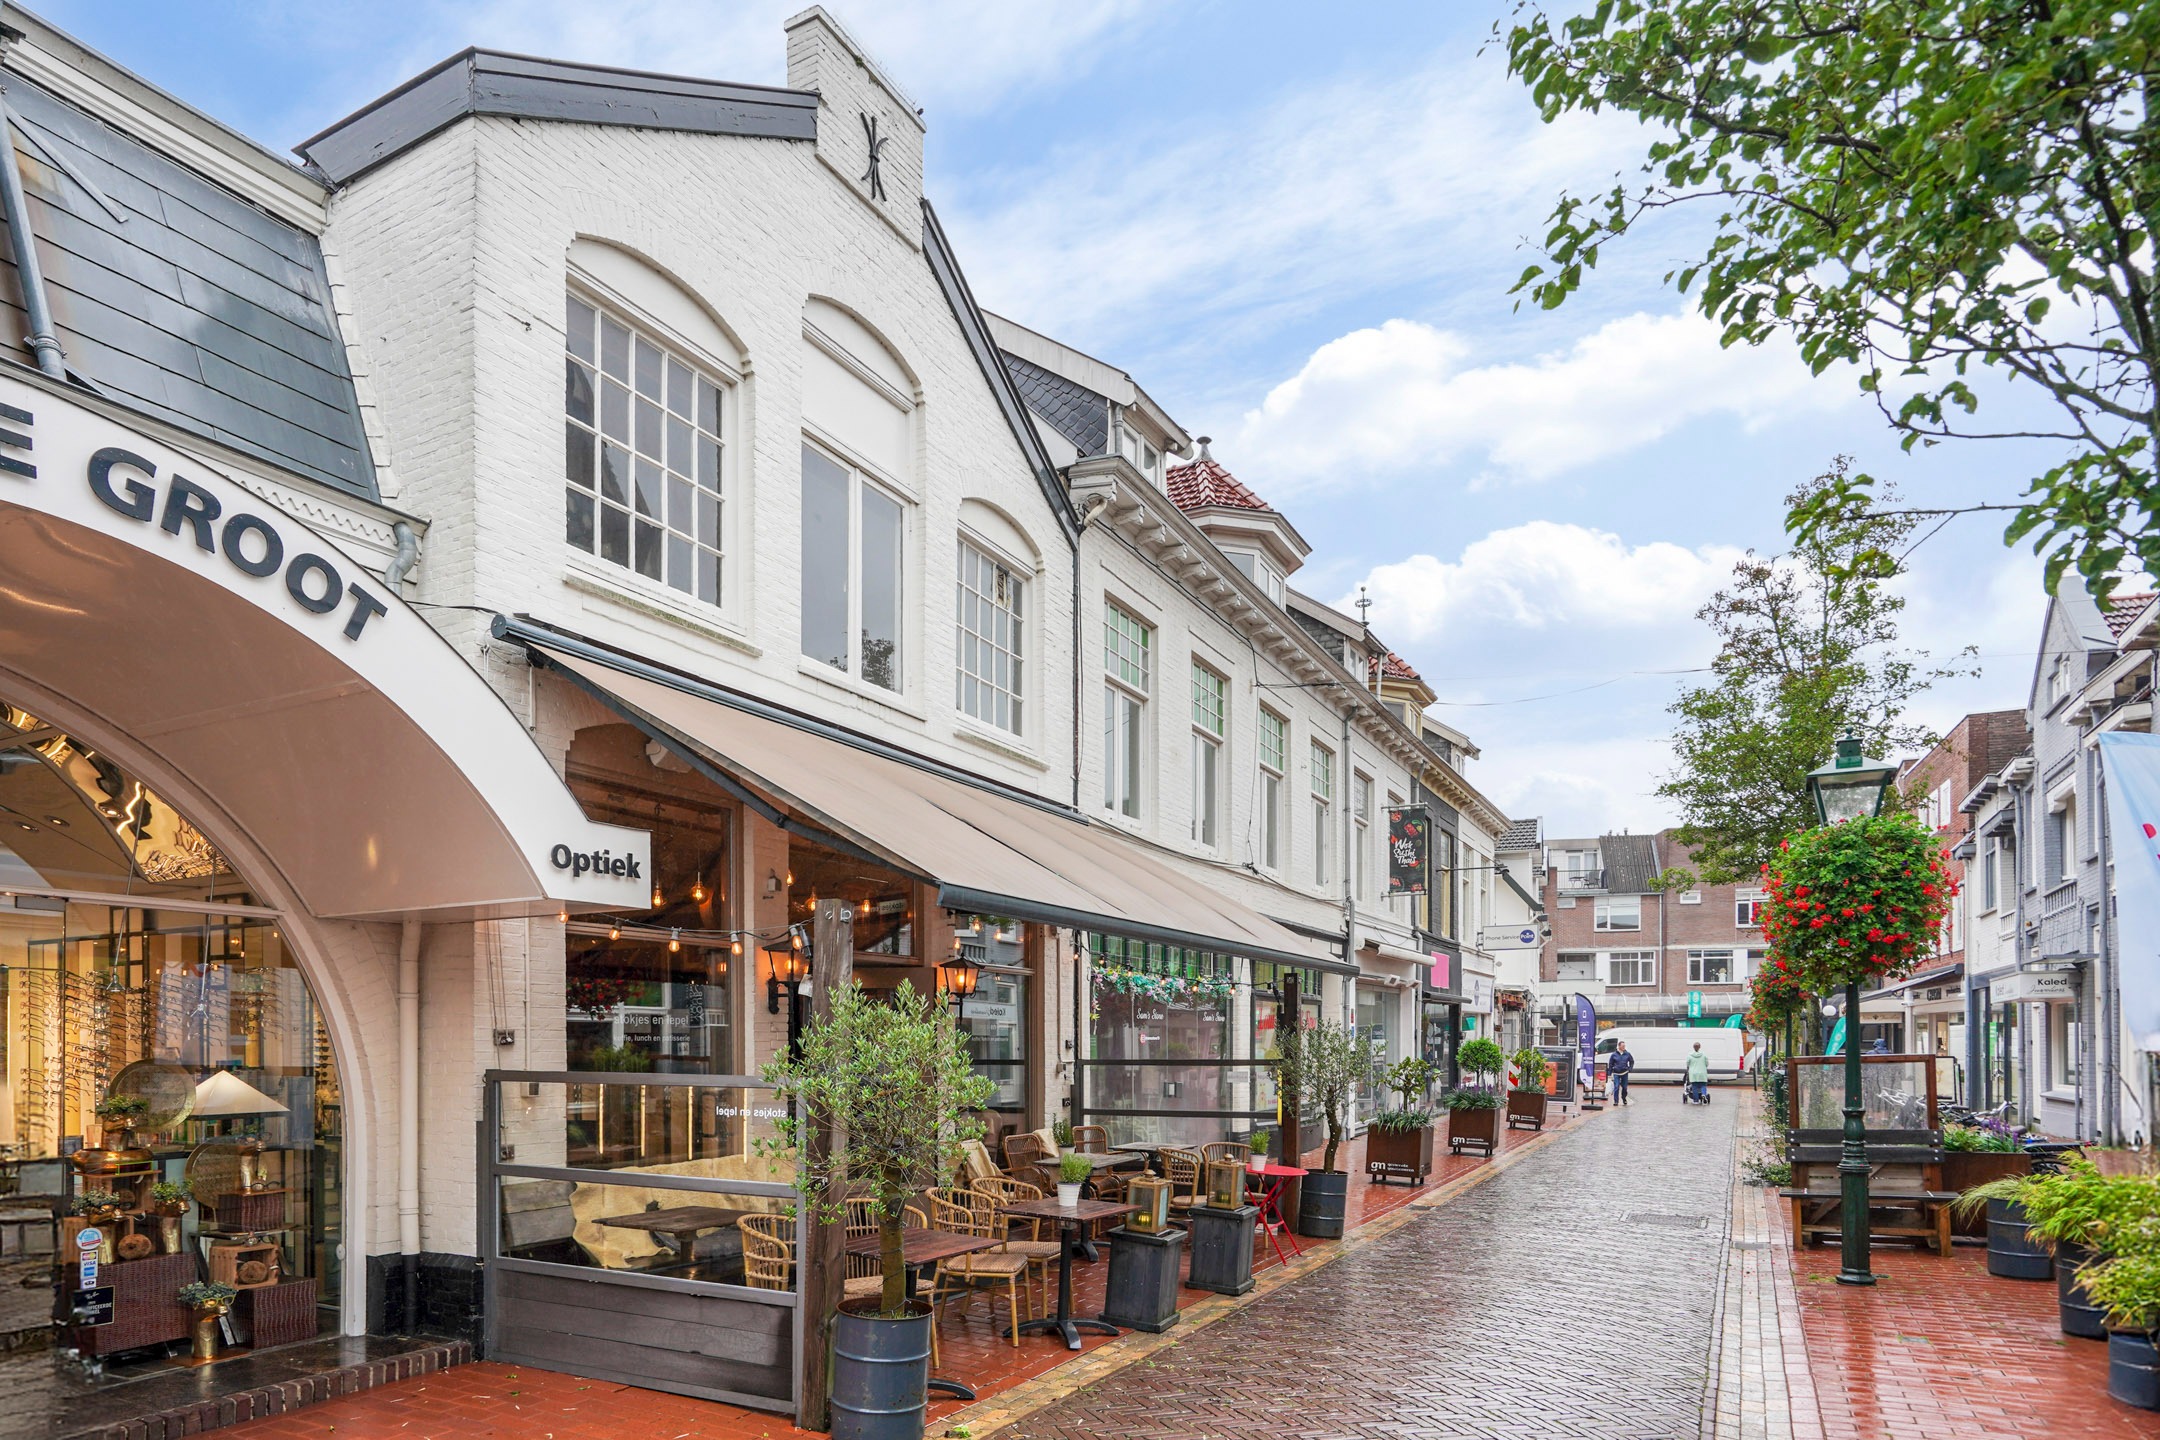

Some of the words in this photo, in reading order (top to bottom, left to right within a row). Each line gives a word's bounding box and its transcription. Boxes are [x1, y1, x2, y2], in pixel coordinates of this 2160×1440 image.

[87, 446, 388, 642] GROOT
[1395, 837, 1413, 850] Wok
[1393, 848, 1415, 858] Sushi
[551, 843, 641, 879] Optiek
[2037, 978, 2067, 986] Kaled
[614, 1014, 650, 1027] stokjes
[652, 1016, 664, 1025] en
[666, 1014, 689, 1027] lepel
